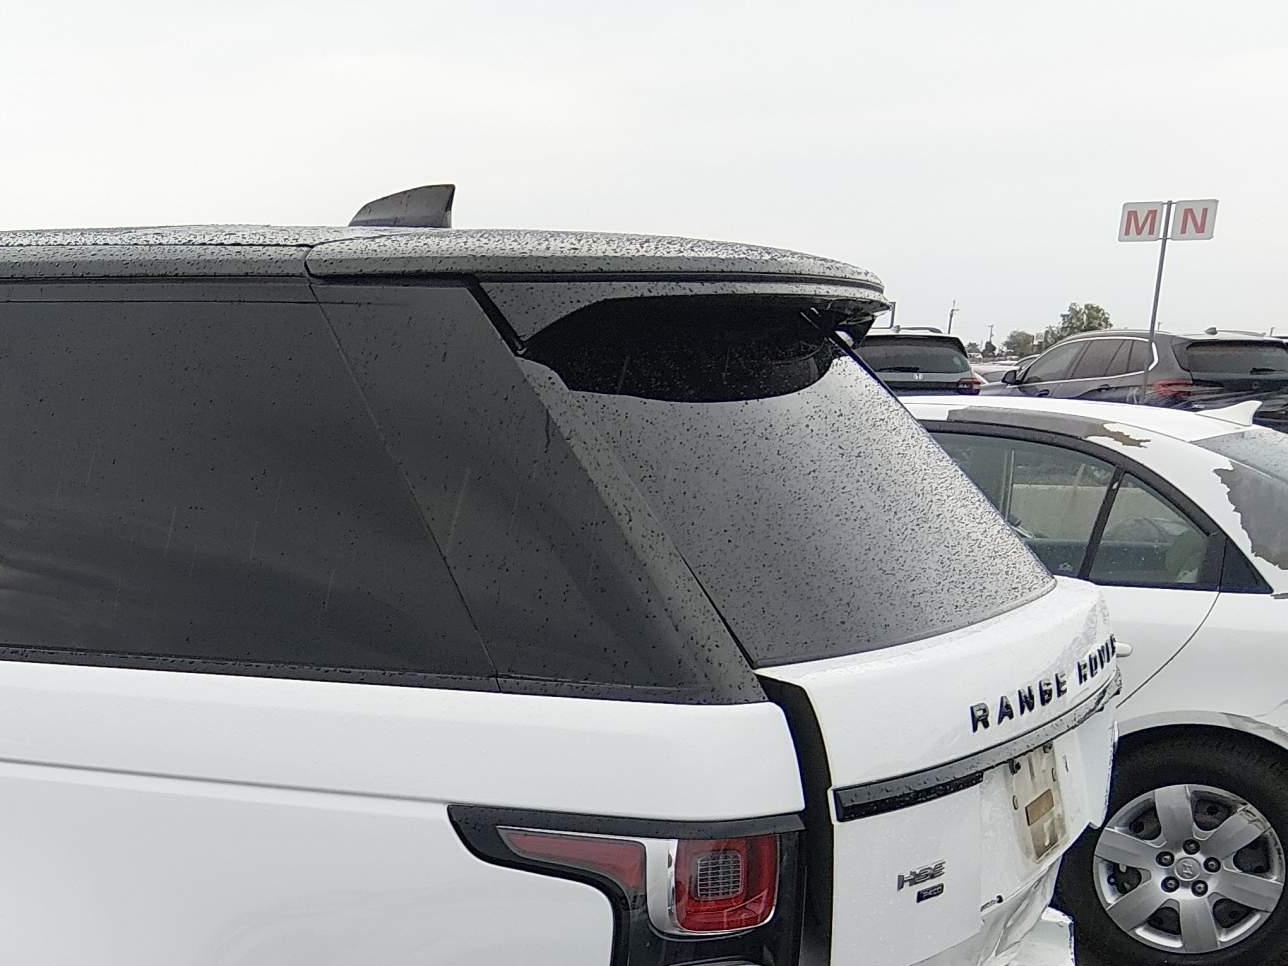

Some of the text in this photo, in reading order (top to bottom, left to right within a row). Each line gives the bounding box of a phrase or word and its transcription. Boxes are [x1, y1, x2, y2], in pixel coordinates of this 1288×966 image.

[1124, 207, 1209, 236] M N
[969, 672, 1068, 734] RANGE
[897, 860, 946, 891] HSE
